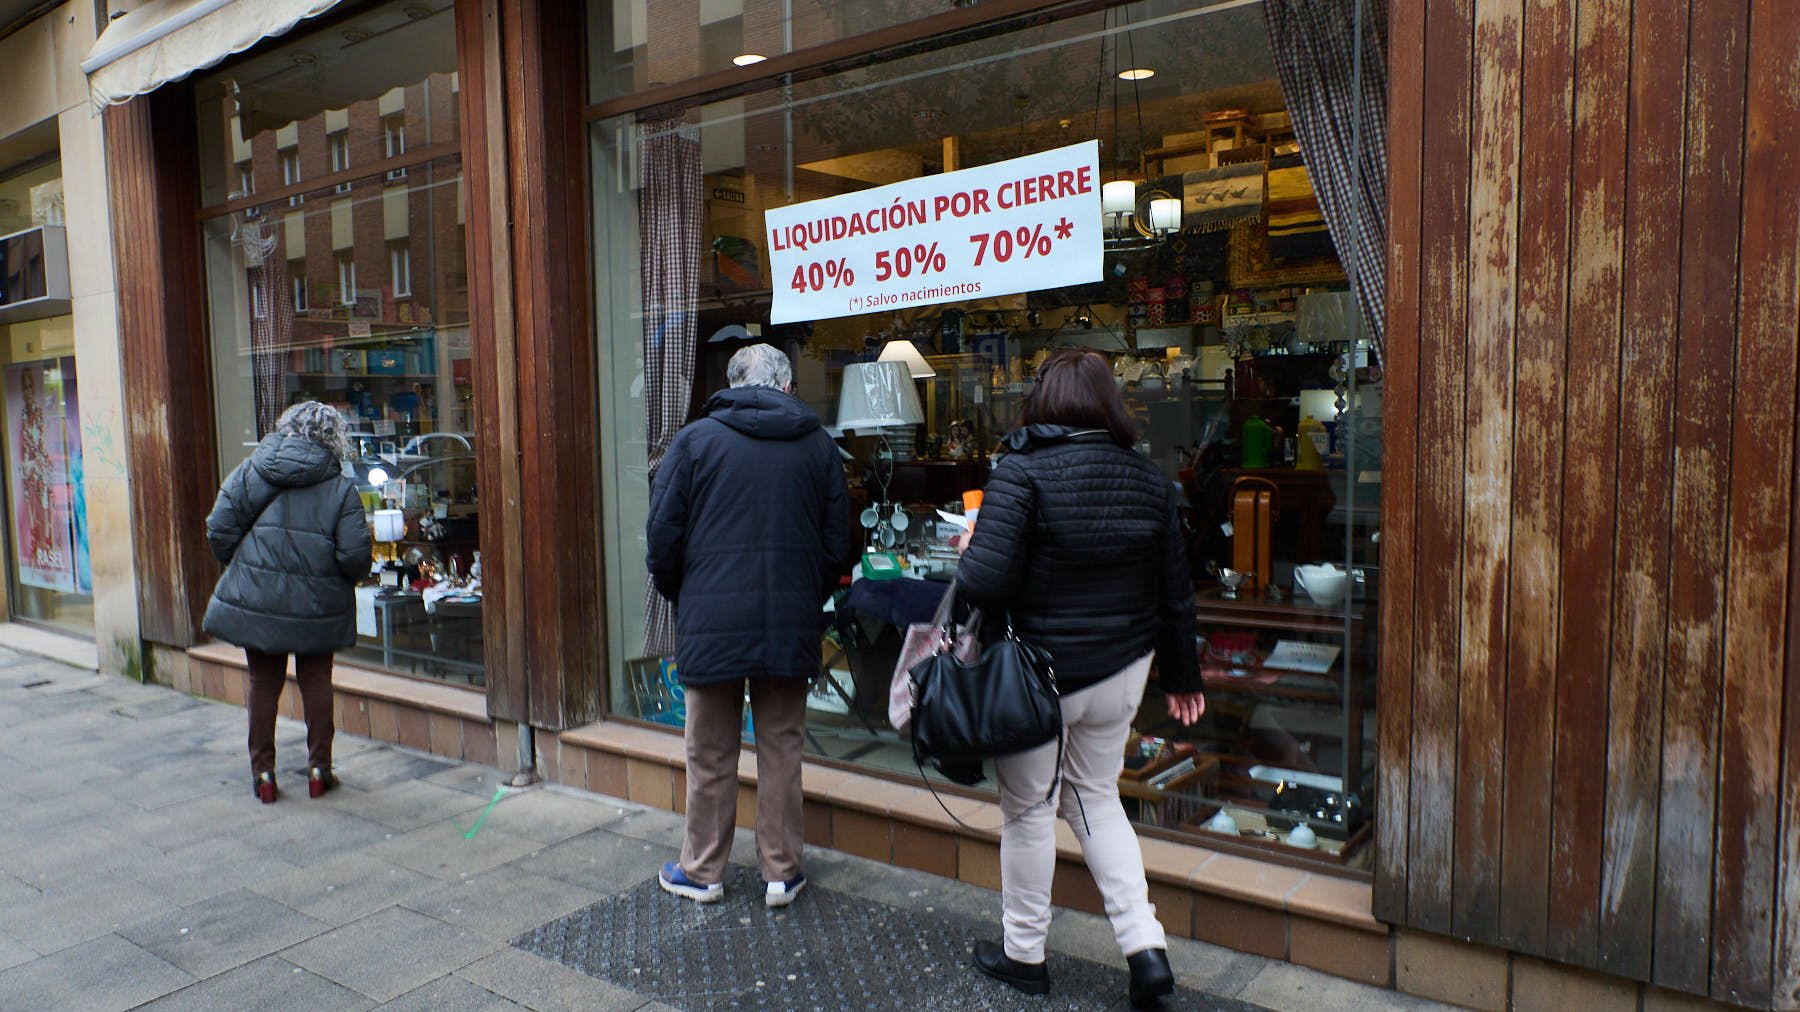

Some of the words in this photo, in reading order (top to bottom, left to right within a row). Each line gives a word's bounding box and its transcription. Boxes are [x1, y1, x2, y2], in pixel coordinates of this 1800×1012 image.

[772, 196, 927, 252] LIQUIDACIÓN
[934, 189, 991, 222] POR
[997, 165, 1092, 210] CIERRE
[791, 257, 855, 294] 40%
[875, 241, 946, 282] 50%
[866, 294, 898, 308] Salvo
[901, 280, 981, 303] nacimientos
